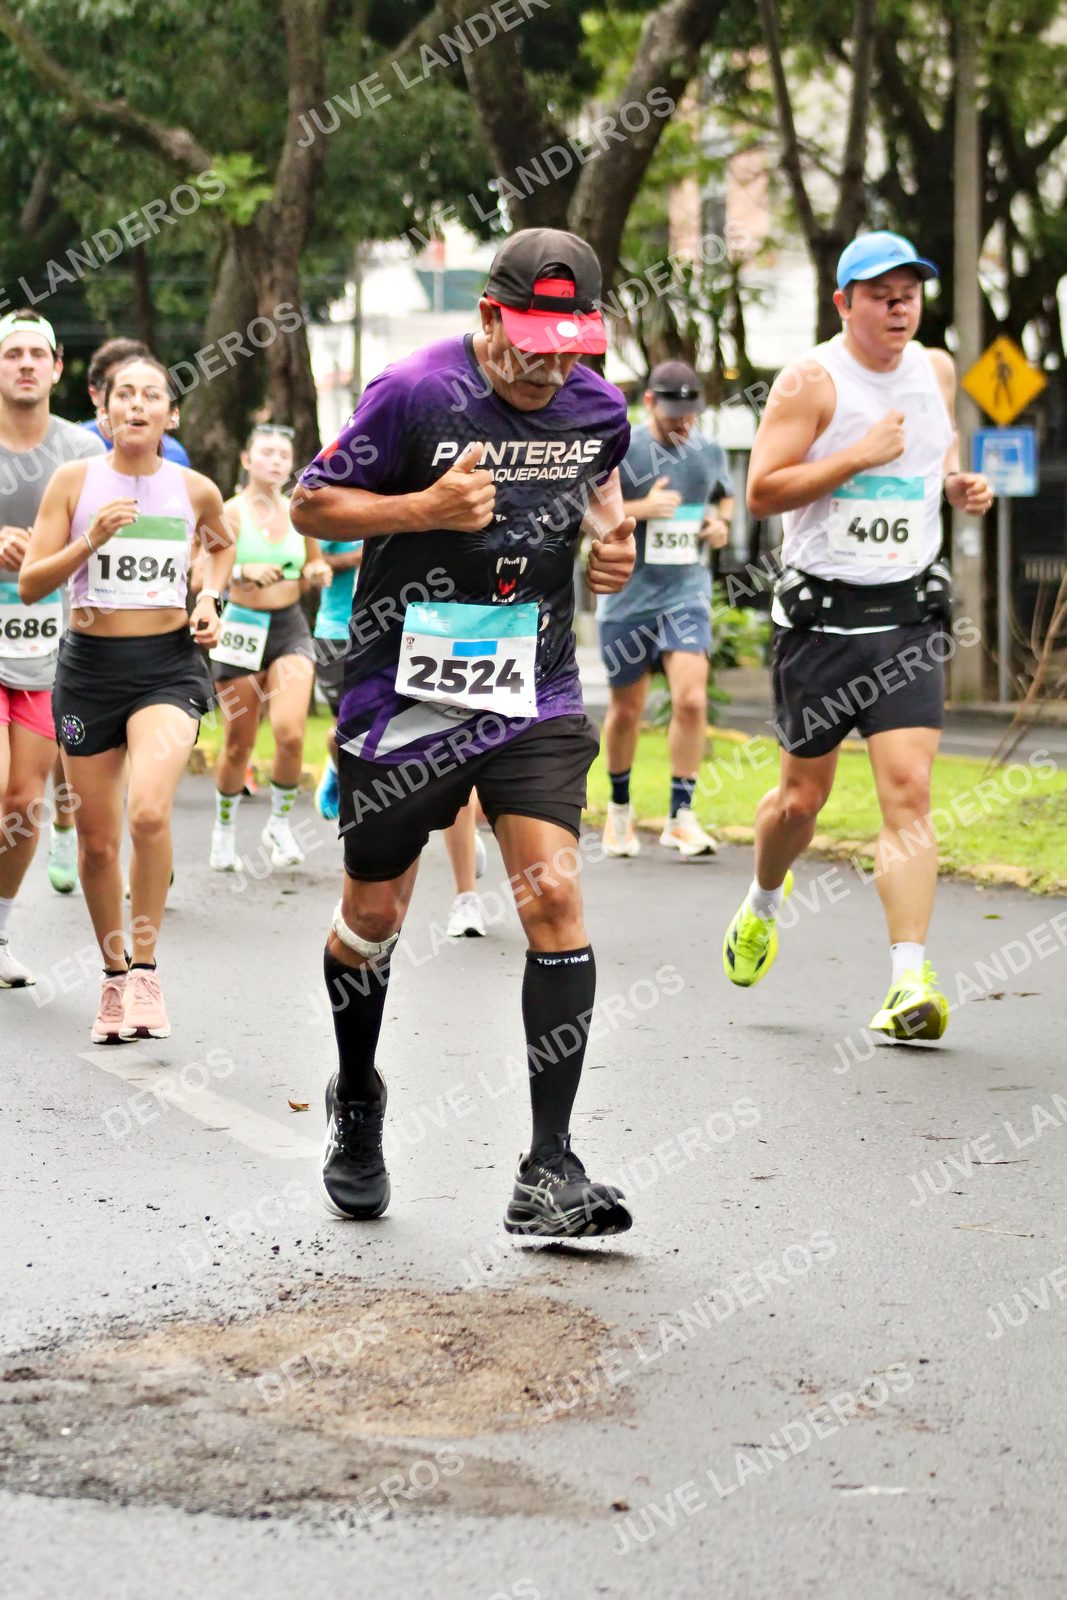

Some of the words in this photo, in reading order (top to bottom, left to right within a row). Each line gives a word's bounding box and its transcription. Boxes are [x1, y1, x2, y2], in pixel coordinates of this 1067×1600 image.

[846, 516, 910, 544] 406
[97, 554, 177, 583] 1894
[0, 617, 58, 639] 686
[221, 631, 259, 654] 895
[407, 655, 525, 695] 2524
